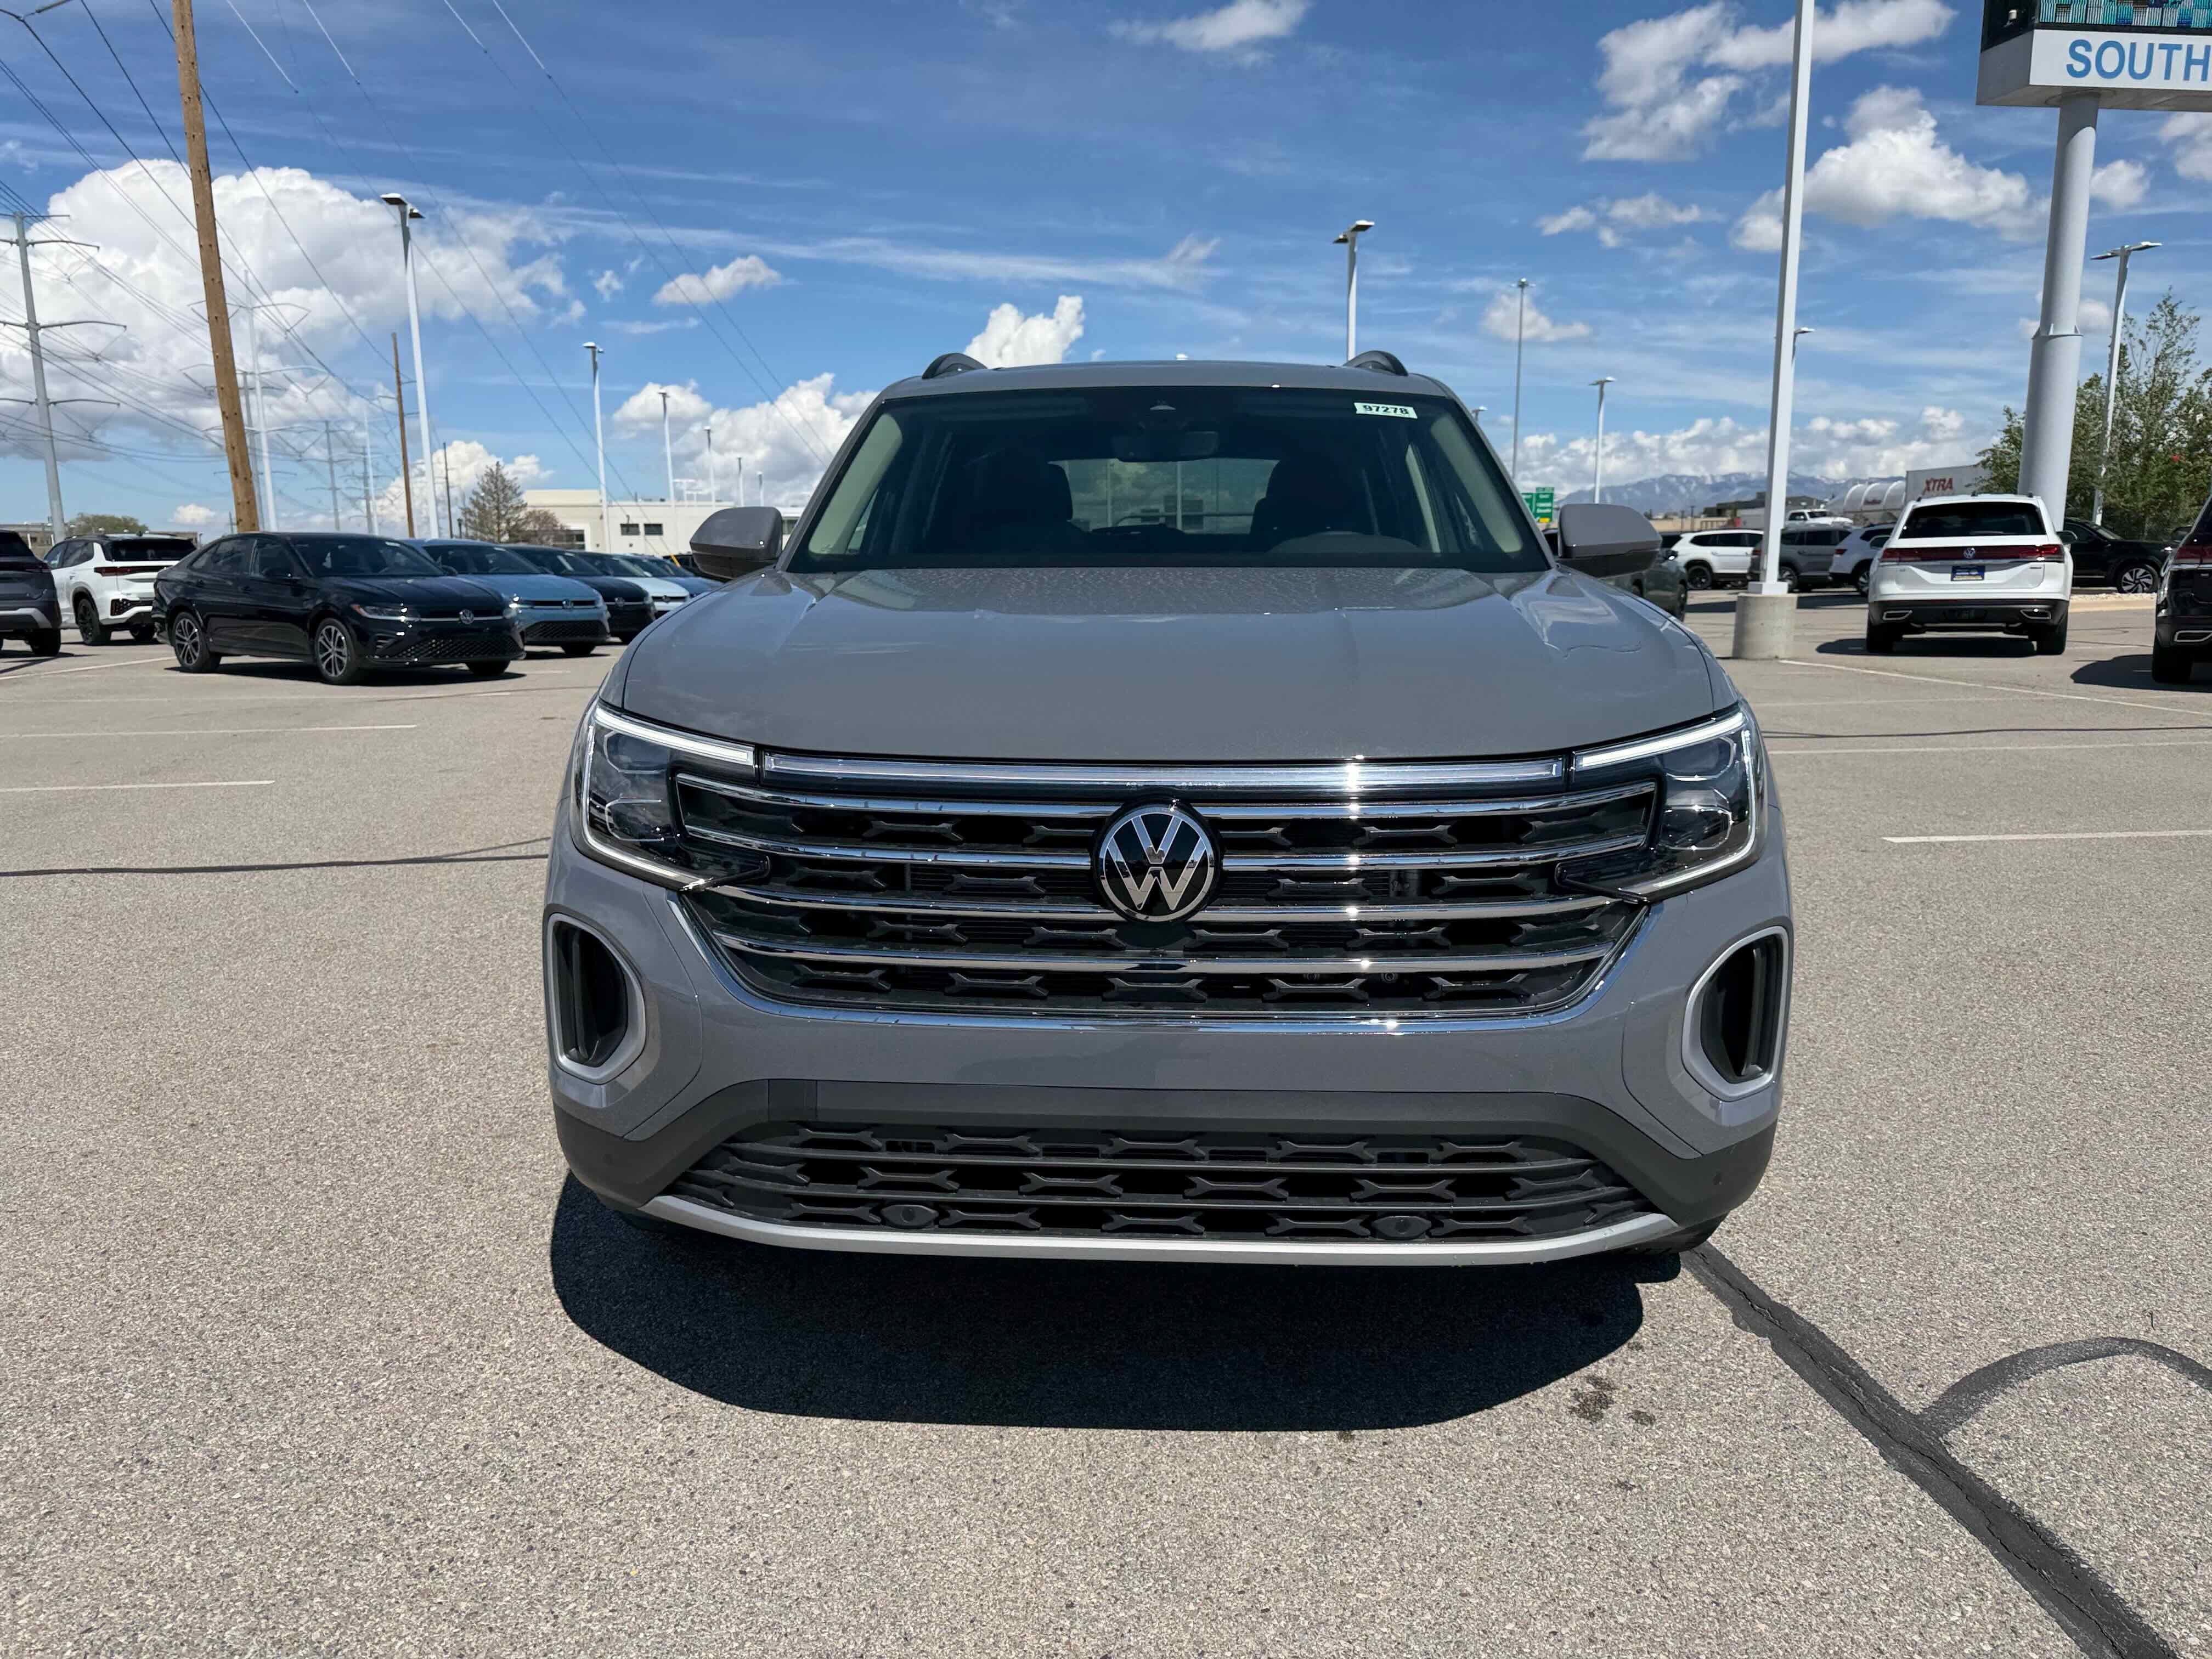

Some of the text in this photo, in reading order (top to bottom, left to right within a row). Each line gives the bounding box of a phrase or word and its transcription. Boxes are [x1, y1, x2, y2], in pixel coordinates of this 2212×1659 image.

[2066, 39, 2211, 82] SOUTH
[1362, 404, 1409, 415] 97278
[1923, 477, 1953, 493] XTRA
[1103, 811, 1211, 916] VW
